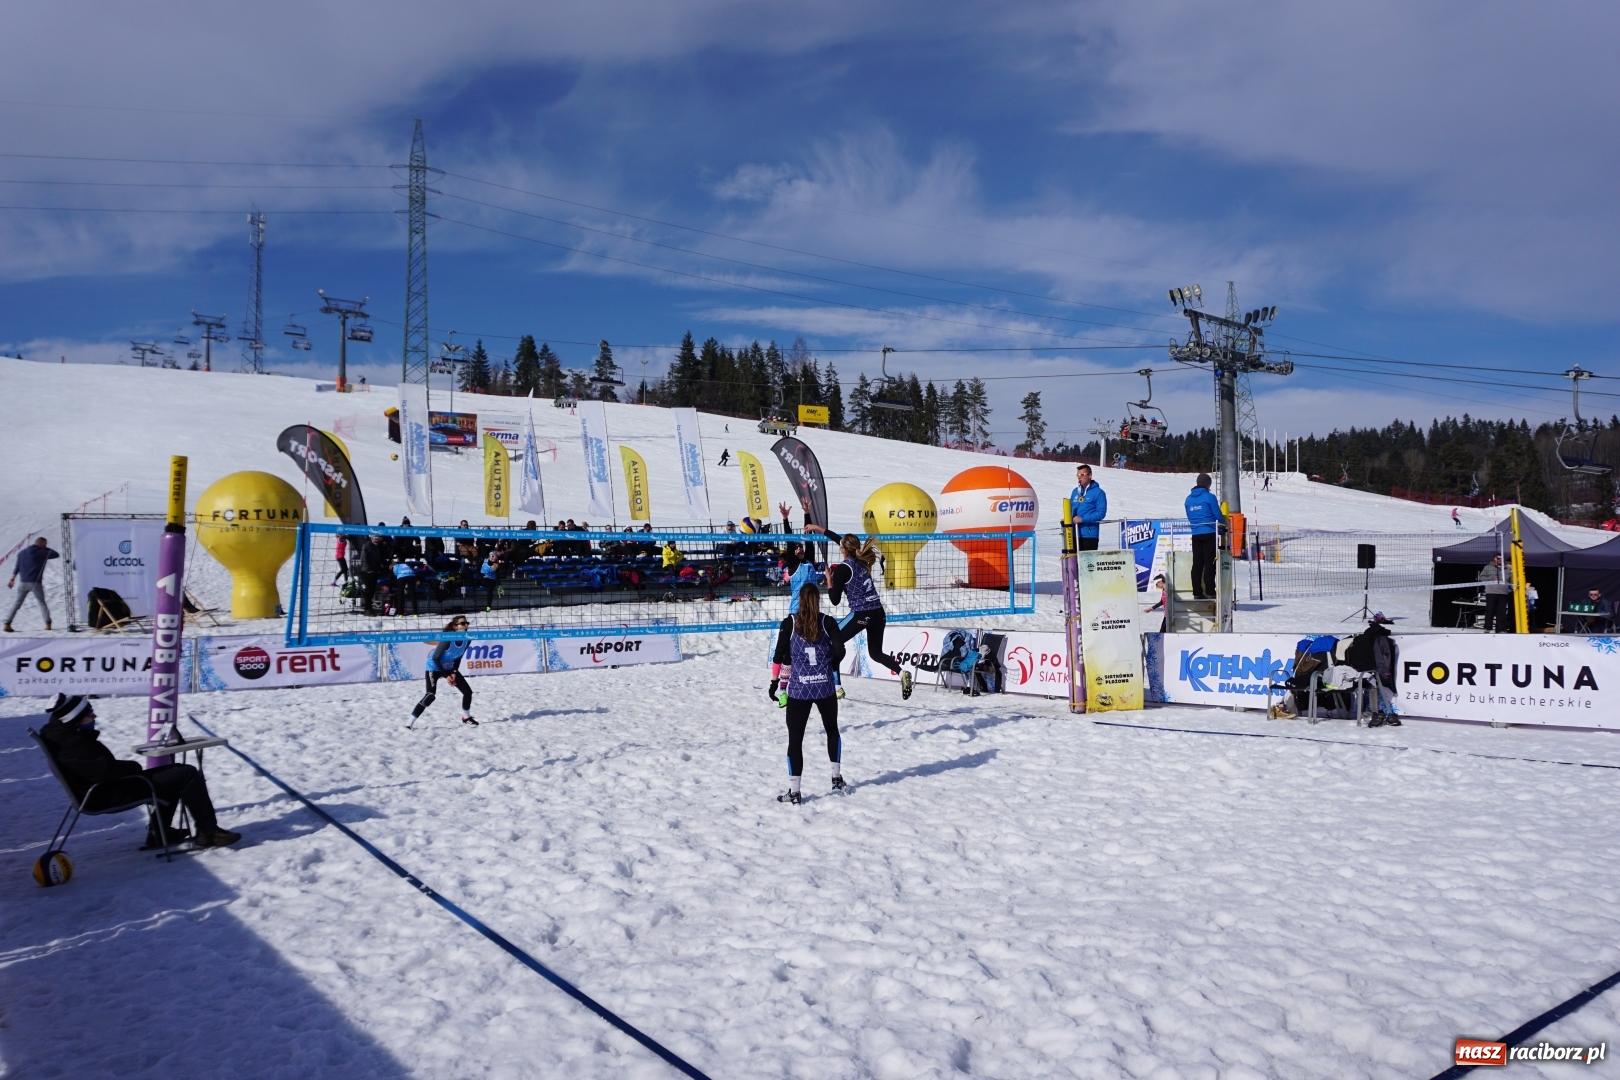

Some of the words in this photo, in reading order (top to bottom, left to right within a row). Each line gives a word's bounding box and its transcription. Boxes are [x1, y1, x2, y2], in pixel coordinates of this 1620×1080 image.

[988, 496, 1035, 513] Terma
[212, 508, 300, 521] FORTUNA
[894, 520, 921, 528] zakłady
[154, 613, 180, 664] BDB
[580, 640, 642, 655] rhSPORT
[276, 648, 340, 674] rent
[804, 647, 818, 665] 1
[890, 651, 938, 667] hSPORT
[16, 656, 152, 673] FORTUNA
[239, 663, 265, 671] 2000
[467, 660, 503, 669] Bania
[18, 676, 63, 685] zakłady
[1040, 671, 1069, 683] SIATK
[1404, 661, 1599, 691] FORTUNA
[150, 673, 177, 742] EVEN
[1406, 691, 1461, 704] zakłady
[1470, 692, 1592, 709] bukmacherskie
